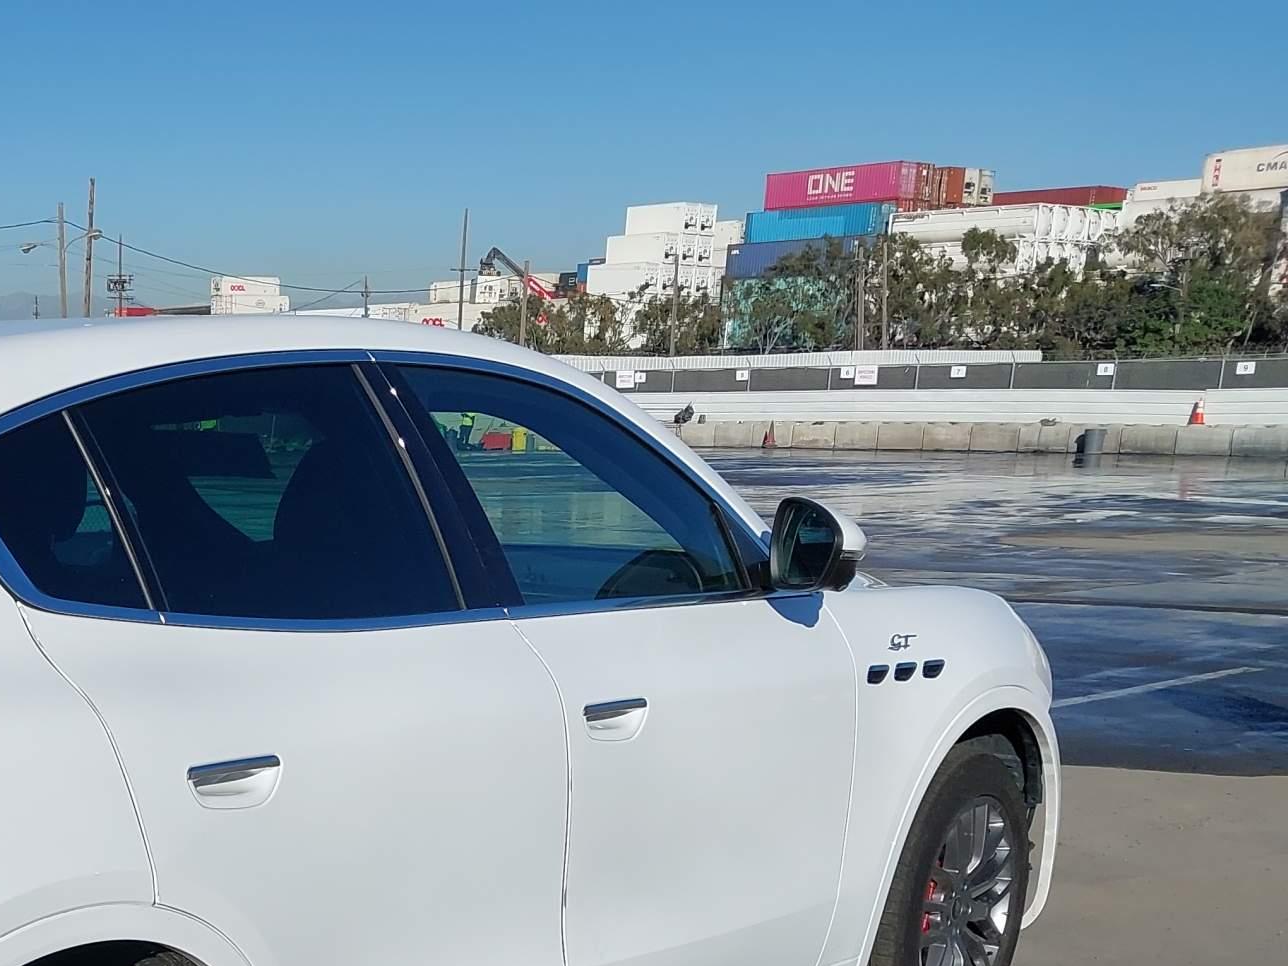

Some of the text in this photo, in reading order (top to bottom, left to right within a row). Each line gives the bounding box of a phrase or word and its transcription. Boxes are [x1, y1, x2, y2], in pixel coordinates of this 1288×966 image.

[1255, 160, 1288, 173] CMA
[807, 170, 855, 195] ONE
[887, 633, 918, 651] GT
